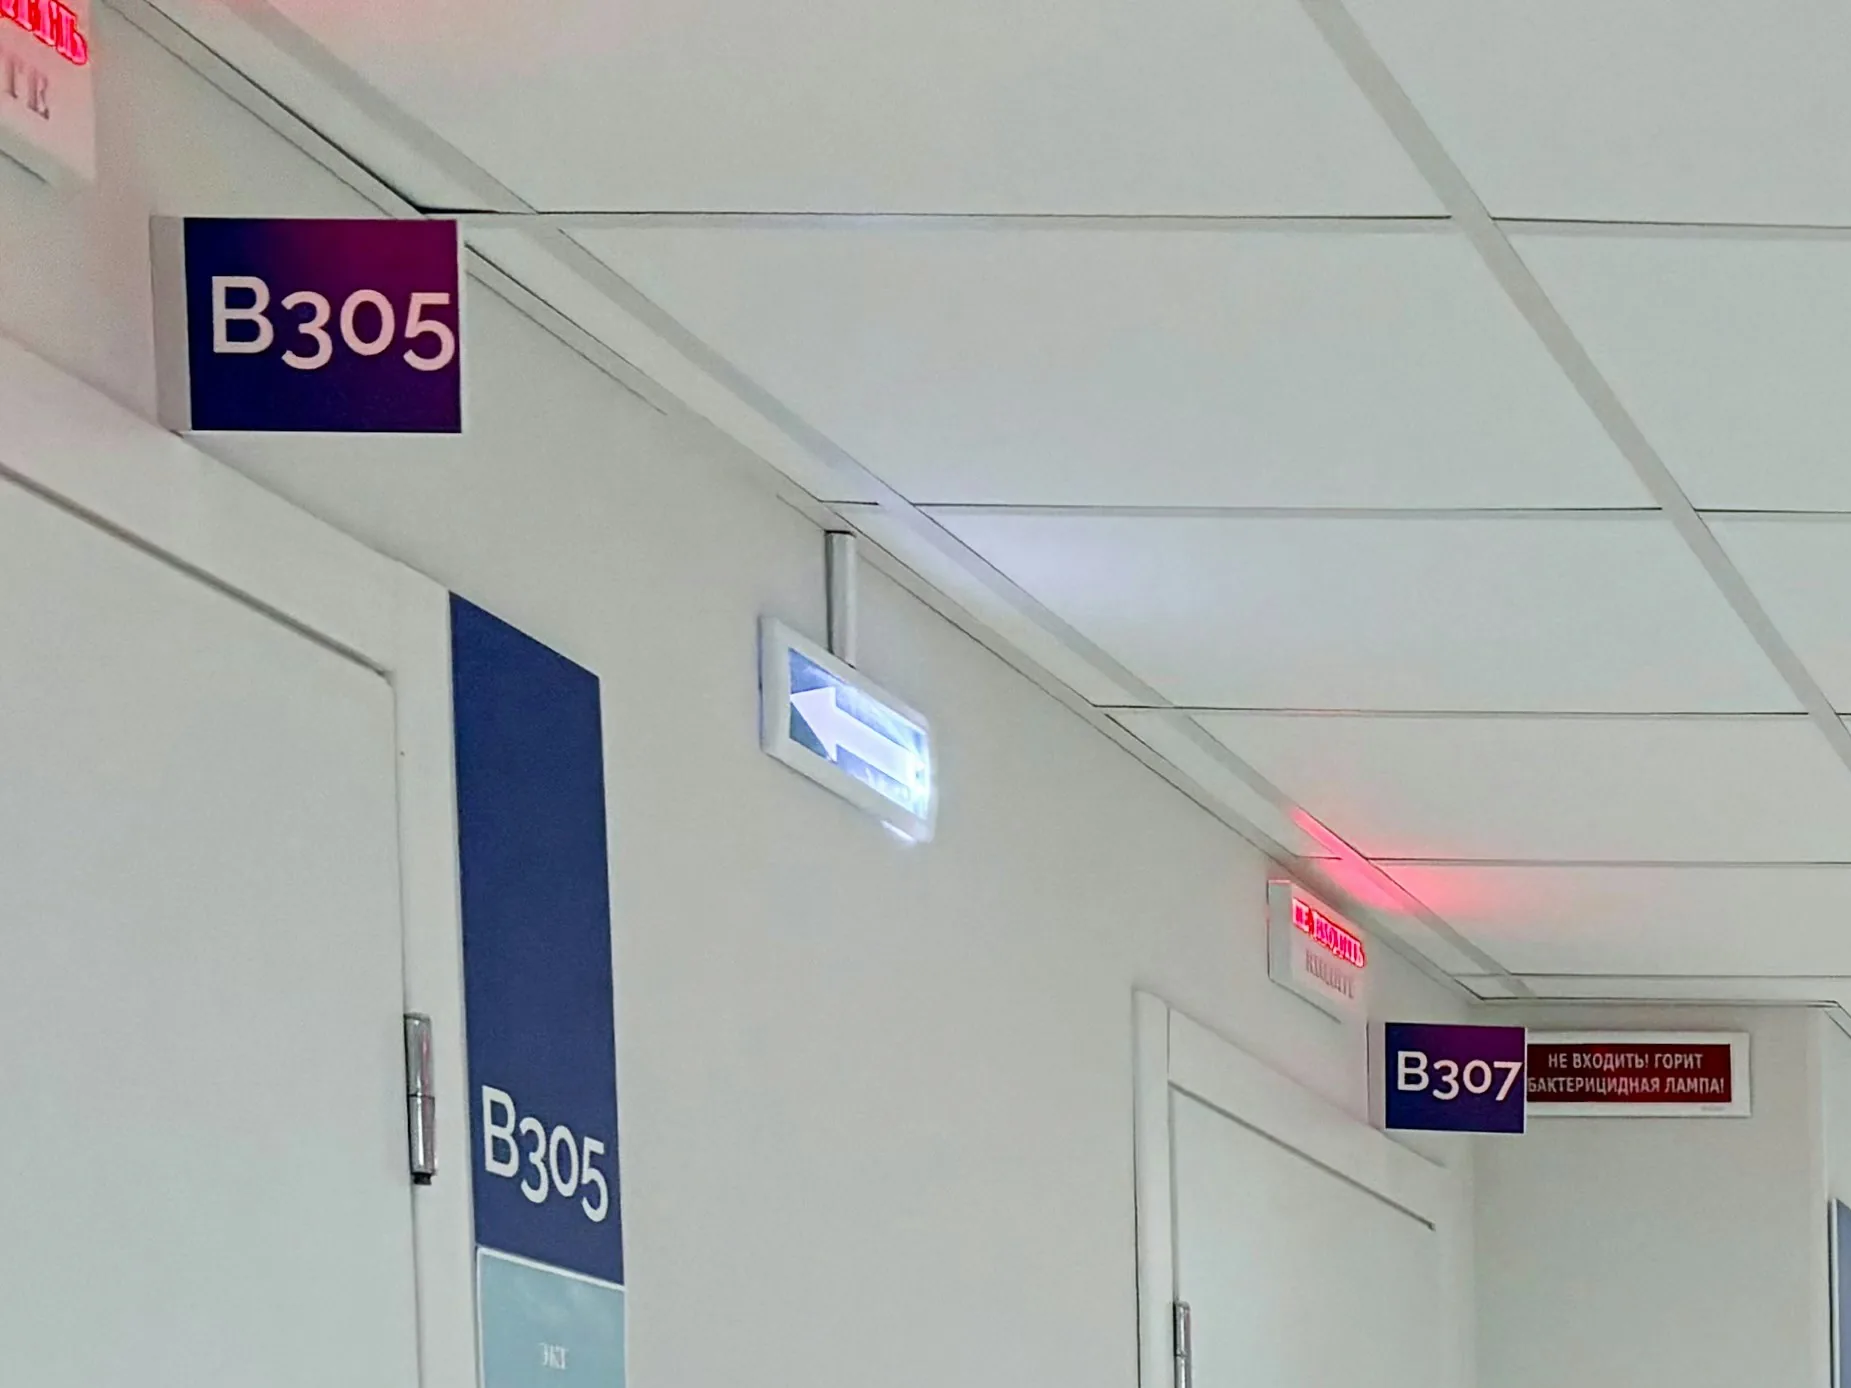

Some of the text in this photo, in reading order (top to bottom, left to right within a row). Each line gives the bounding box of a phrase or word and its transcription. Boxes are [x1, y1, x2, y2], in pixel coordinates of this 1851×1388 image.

[211, 275, 457, 371] B305
[1396, 1049, 1524, 1101] B307
[1527, 1076, 1726, 1096] БАКТЕРИЦИДНАЯ ЛАМПА!
[1548, 1052, 1704, 1072] НЕ ВХОДИТЬ! ГОРИТ
[481, 1085, 610, 1223] B305
